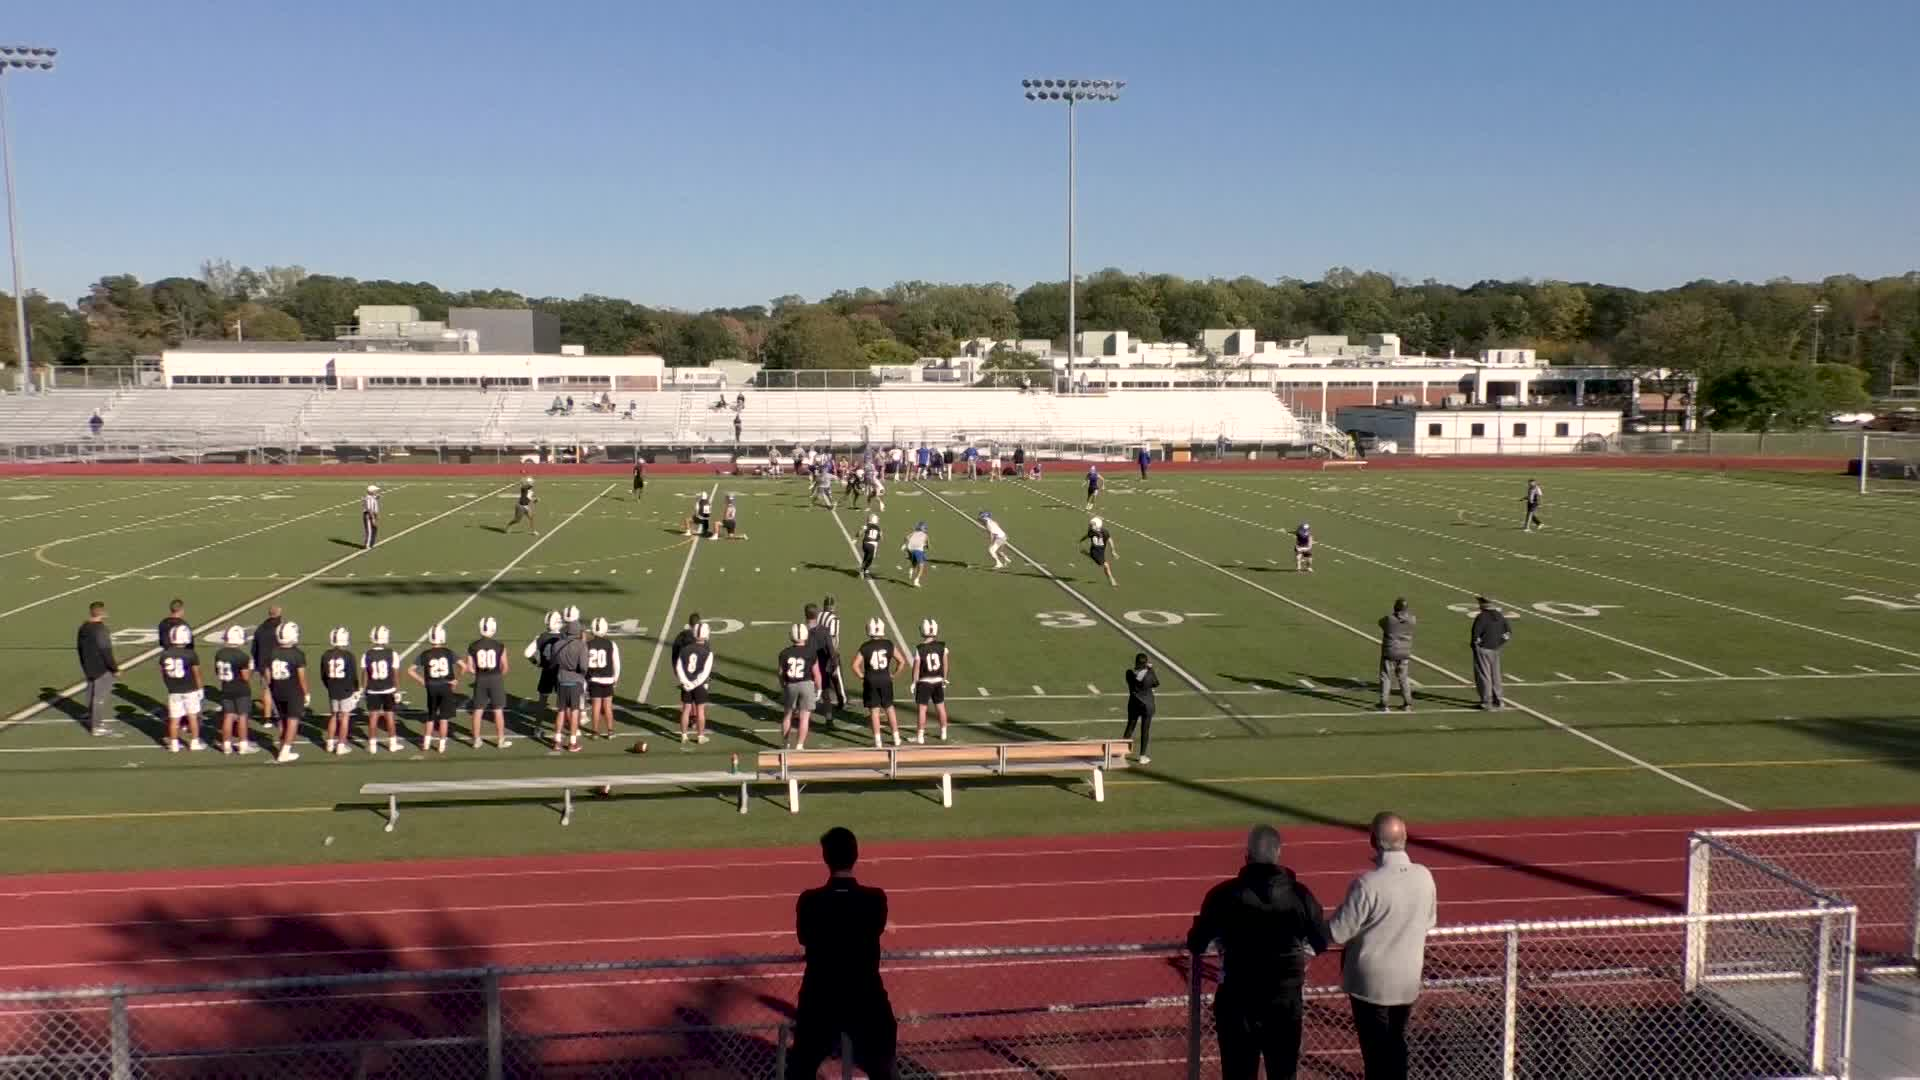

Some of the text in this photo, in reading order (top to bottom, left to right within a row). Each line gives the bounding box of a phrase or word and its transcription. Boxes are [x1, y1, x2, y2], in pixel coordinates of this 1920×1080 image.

[327, 658, 345, 678] 12
[476, 649, 497, 669] 80
[588, 649, 607, 668] 20
[687, 653, 698, 673] 8
[787, 657, 805, 678] 32
[869, 649, 888, 670] 45
